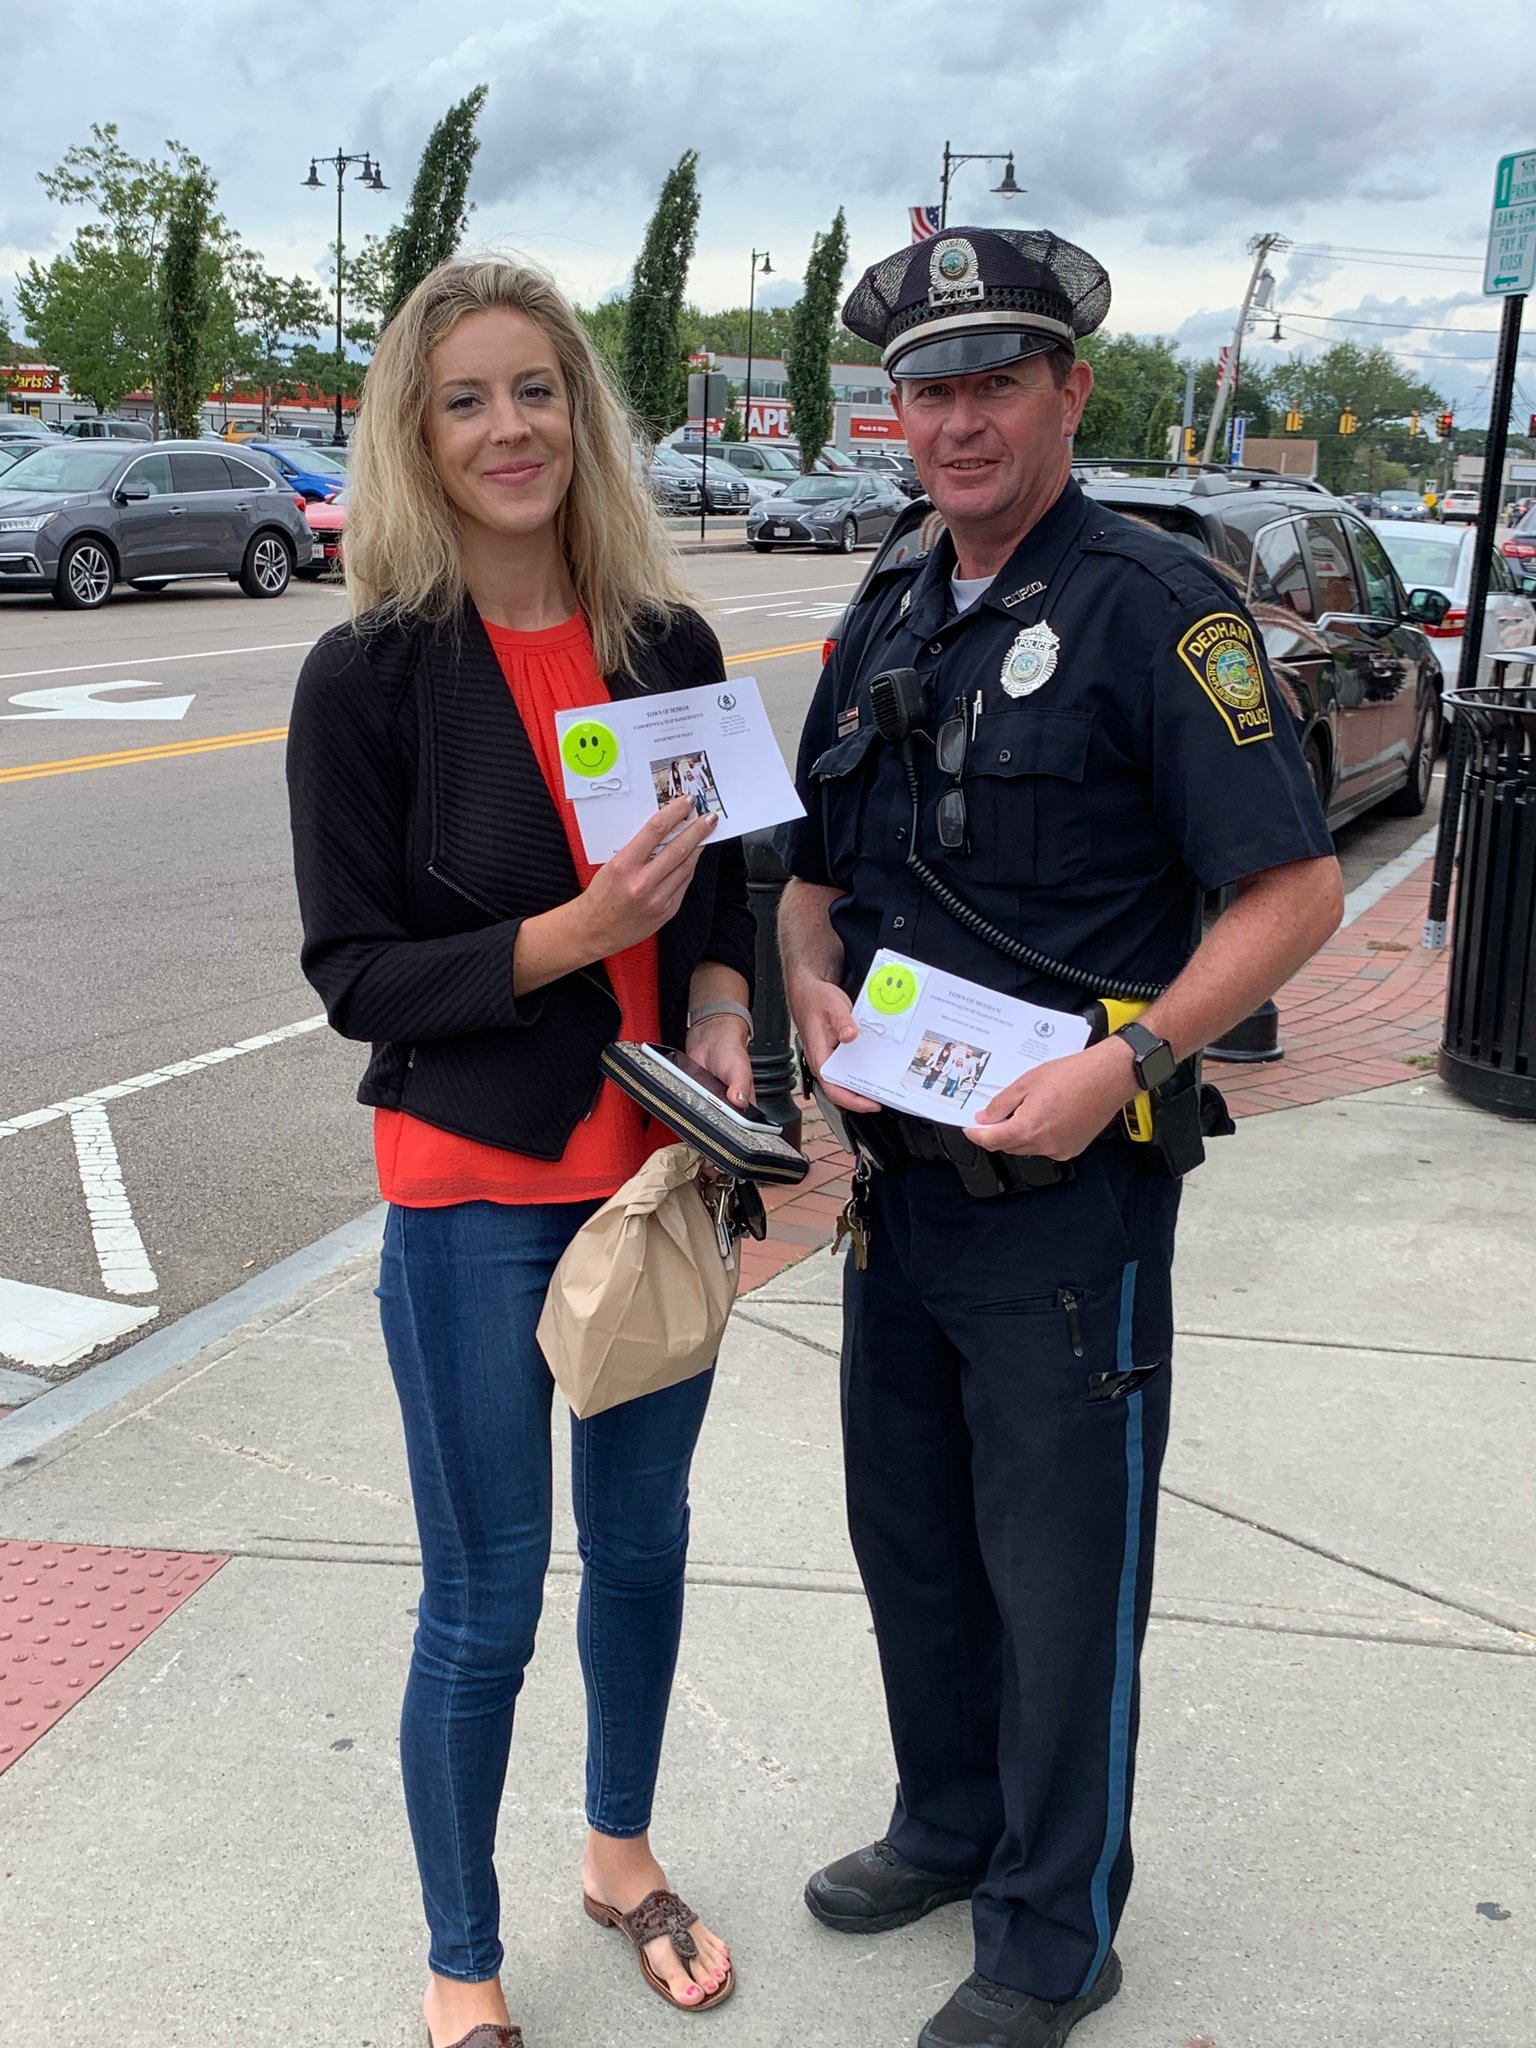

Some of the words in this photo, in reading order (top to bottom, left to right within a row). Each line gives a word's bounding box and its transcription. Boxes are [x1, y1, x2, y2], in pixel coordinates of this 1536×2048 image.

[1511, 181, 1536, 201] PARKIN
[1500, 236, 1516, 254] PAY
[1518, 233, 1528, 251] AT
[1500, 253, 1523, 271] KIOSK
[1018, 639, 1052, 652] POLICE
[1187, 622, 1249, 659] DEDHAM
[1237, 706, 1269, 730] POLICE
